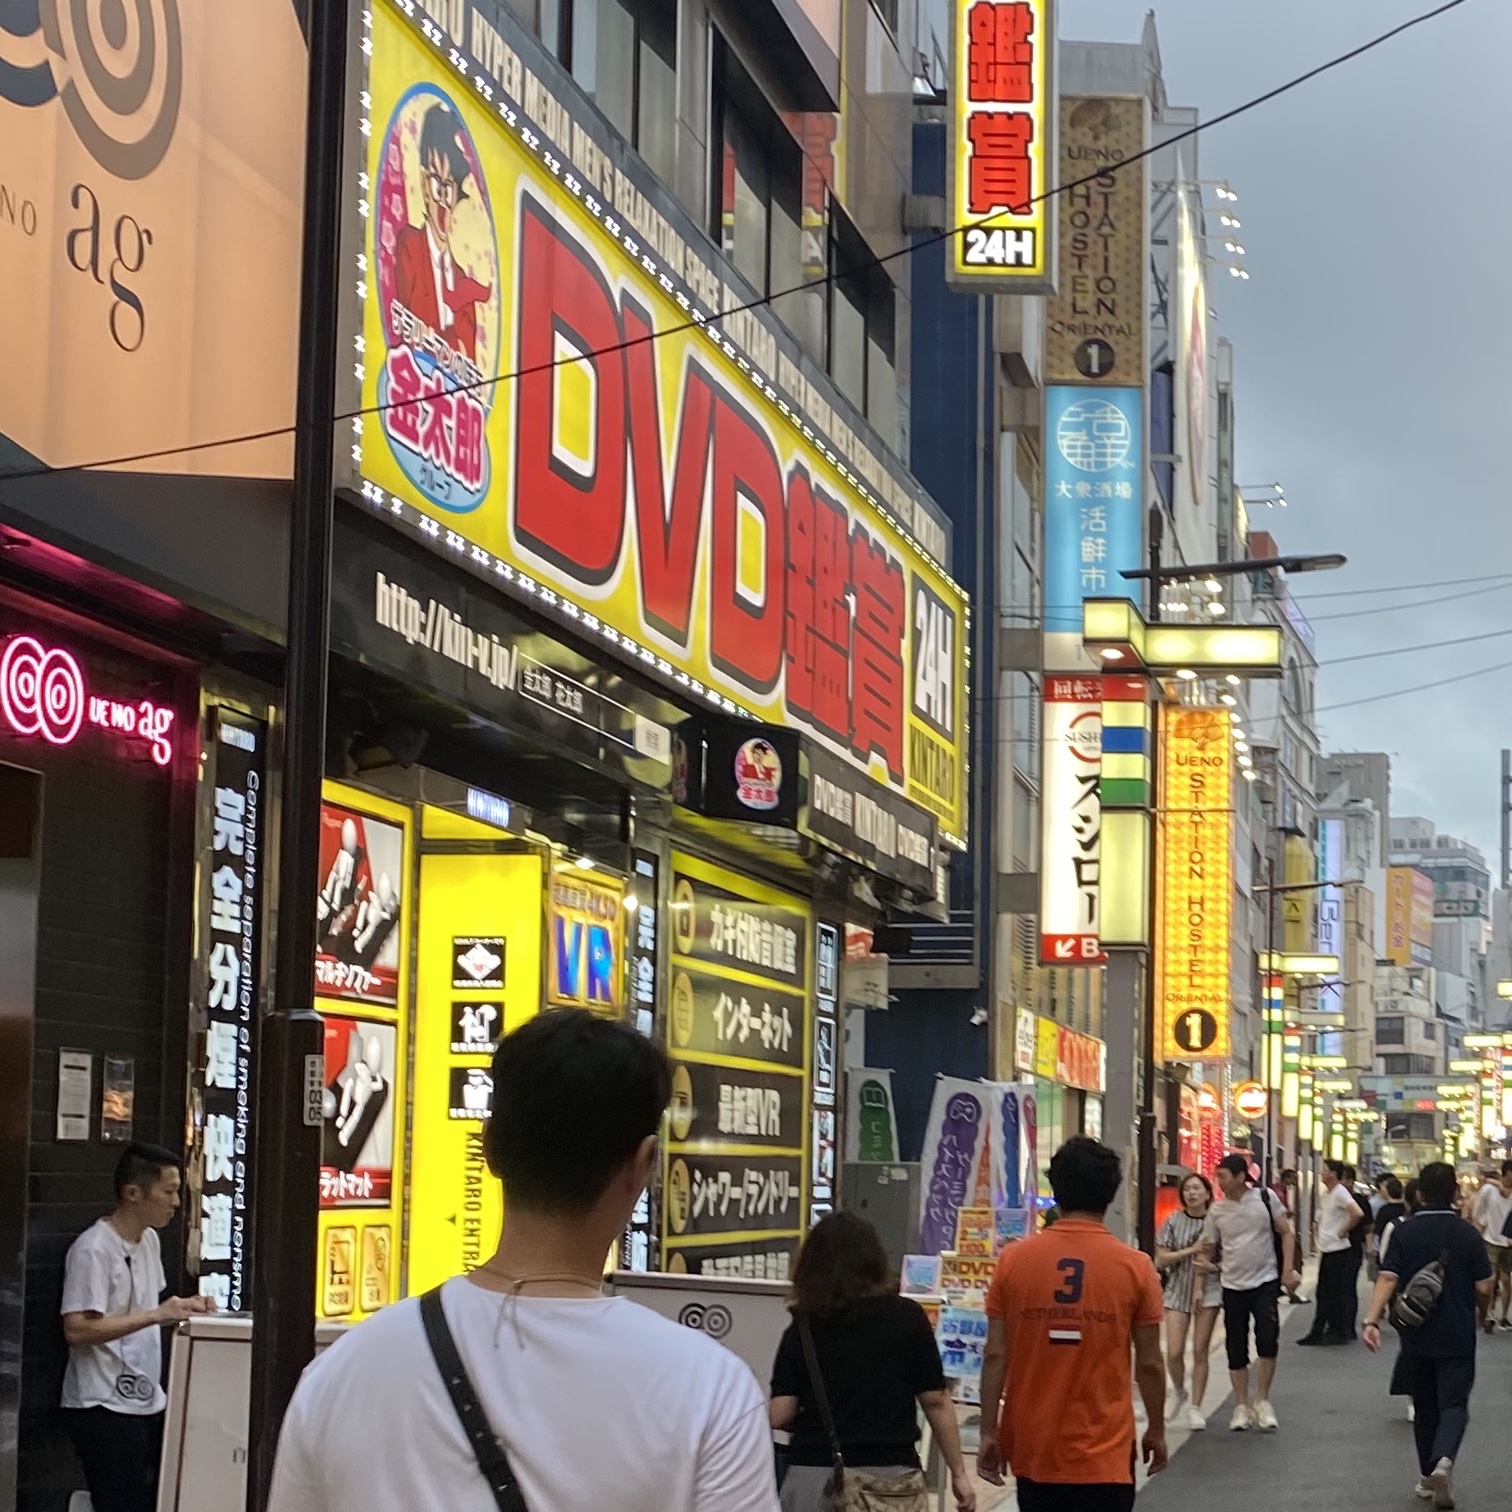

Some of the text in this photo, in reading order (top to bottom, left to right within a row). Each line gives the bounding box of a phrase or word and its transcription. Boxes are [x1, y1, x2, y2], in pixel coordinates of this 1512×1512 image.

[967, 1, 1034, 214] 鑑賞
[471, 6, 522, 107] HYPER
[524, 67, 571, 160] MEDIA
[572, 121, 614, 204] MEN'S
[686, 245, 720, 316] SPACE
[1067, 146, 1124, 162] UENO
[66, 183, 153, 352] ag
[965, 229, 1033, 265] 24H
[1069, 187, 1090, 315] HOSTEL
[1096, 167, 1117, 316] STATION
[1051, 320, 1138, 338] ORIENTAL
[384, 348, 486, 492] 金太郎
[1055, 480, 1132, 499] 大衆酒場
[914, 587, 955, 736] 24H
[1053, 680, 1102, 700] 回転
[89, 696, 136, 732] UENO
[138, 700, 174, 766] ag
[1176, 755, 1224, 766] UENO
[1071, 774, 1101, 924] スシロー
[1189, 773, 1206, 880] STATION
[205, 785, 246, 1090] 完全分煙
[554, 914, 613, 1005] VR
[709, 903, 797, 976] カギ付防音個室
[1080, 938, 1101, 958] B
[1188, 896, 1206, 988] HOSTEL
[229, 769, 261, 1312] Complete separation of smoking and nonsmo
[711, 991, 793, 1053] インターネット
[717, 1083, 781, 1137] 最新型VR
[319, 1170, 374, 1199] ラットマット
[463, 1130, 484, 1213] KINTARO
[198, 1112, 236, 1313] 快適空
[461, 1216, 484, 1272] ENTRA
[1054, 1257, 1085, 1304] 3
